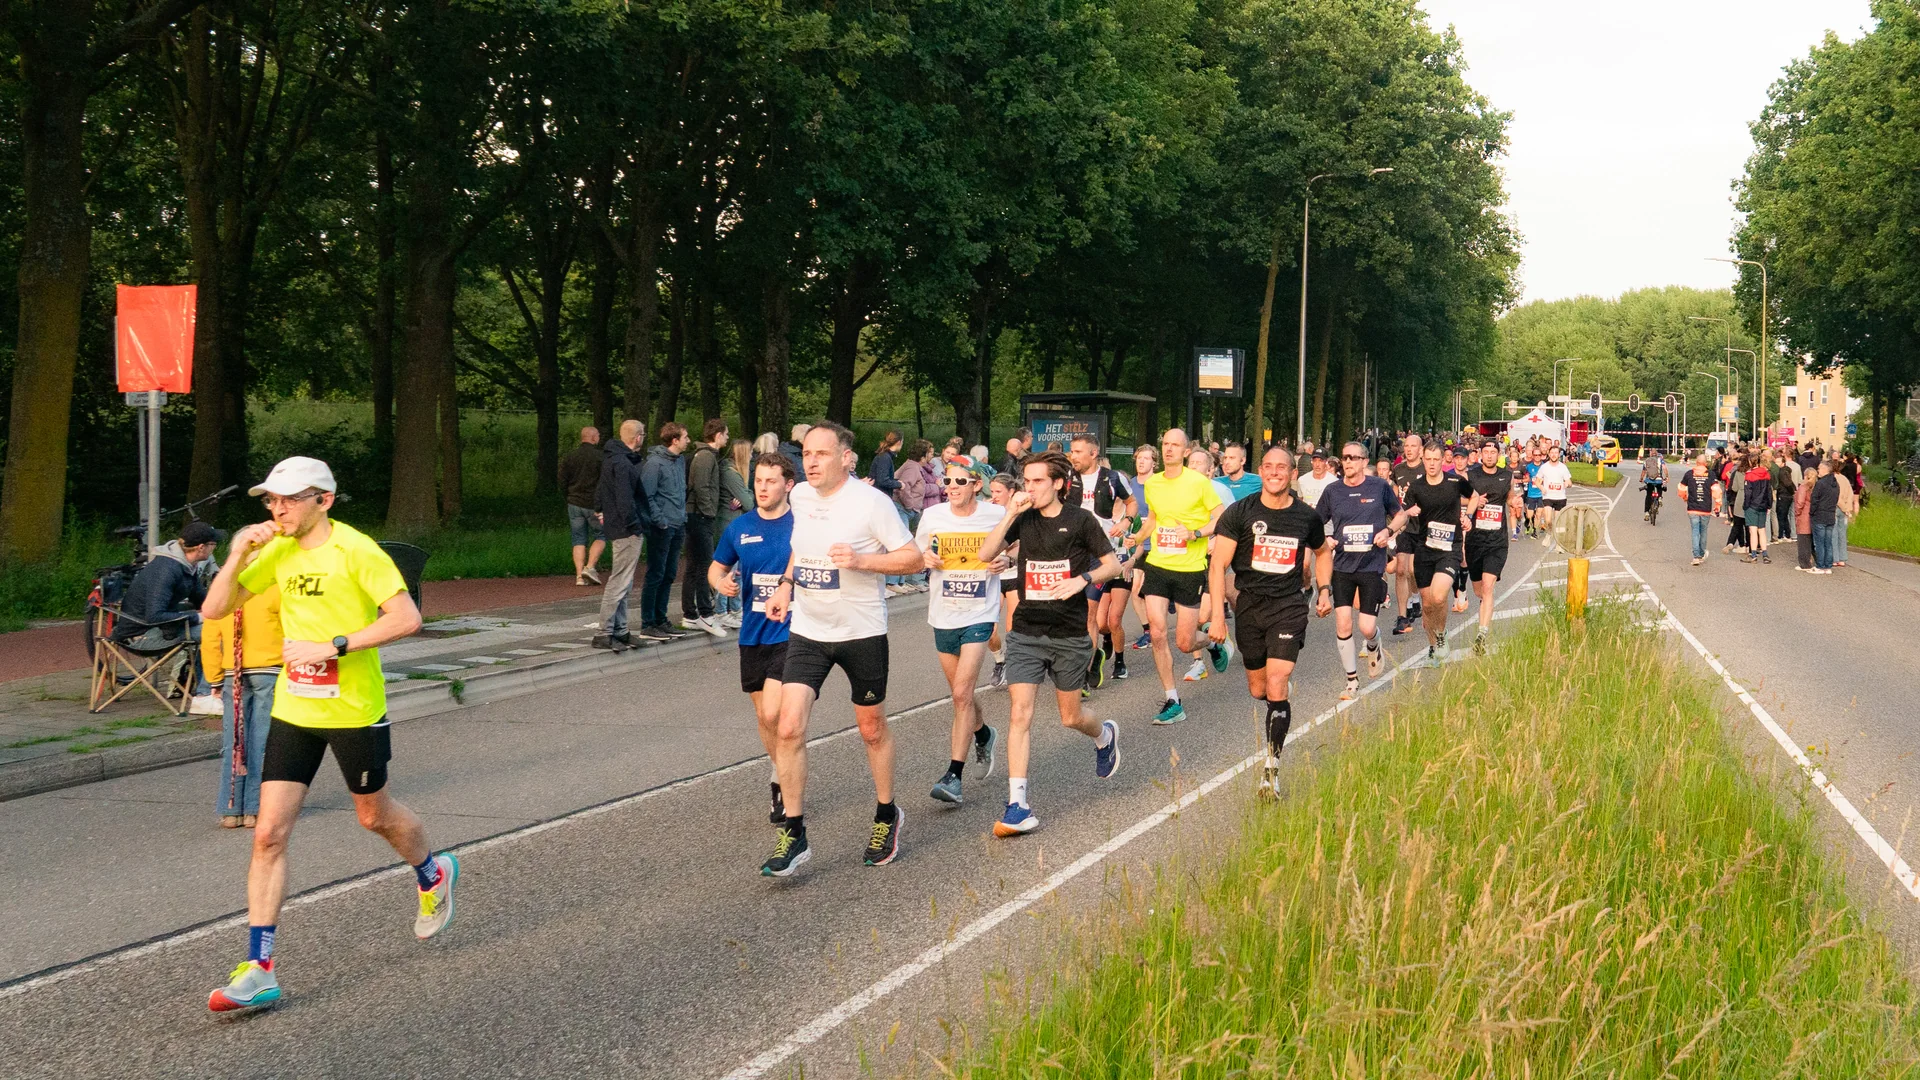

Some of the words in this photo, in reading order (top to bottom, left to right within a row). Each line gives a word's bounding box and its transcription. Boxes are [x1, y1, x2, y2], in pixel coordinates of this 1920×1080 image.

[1045, 423, 1062, 433] HET
[1037, 432, 1073, 442] VOORSPEL
[1481, 511, 1499, 519] 1120
[1347, 533, 1369, 541] 3653
[1430, 528, 1450, 539] 3570
[1268, 538, 1295, 546] SCANIA
[1260, 546, 1291, 560] 1733
[800, 557, 822, 565] CRAFT
[798, 568, 832, 583] 3936
[1032, 573, 1064, 585] 1835
[948, 581, 980, 593] 3947
